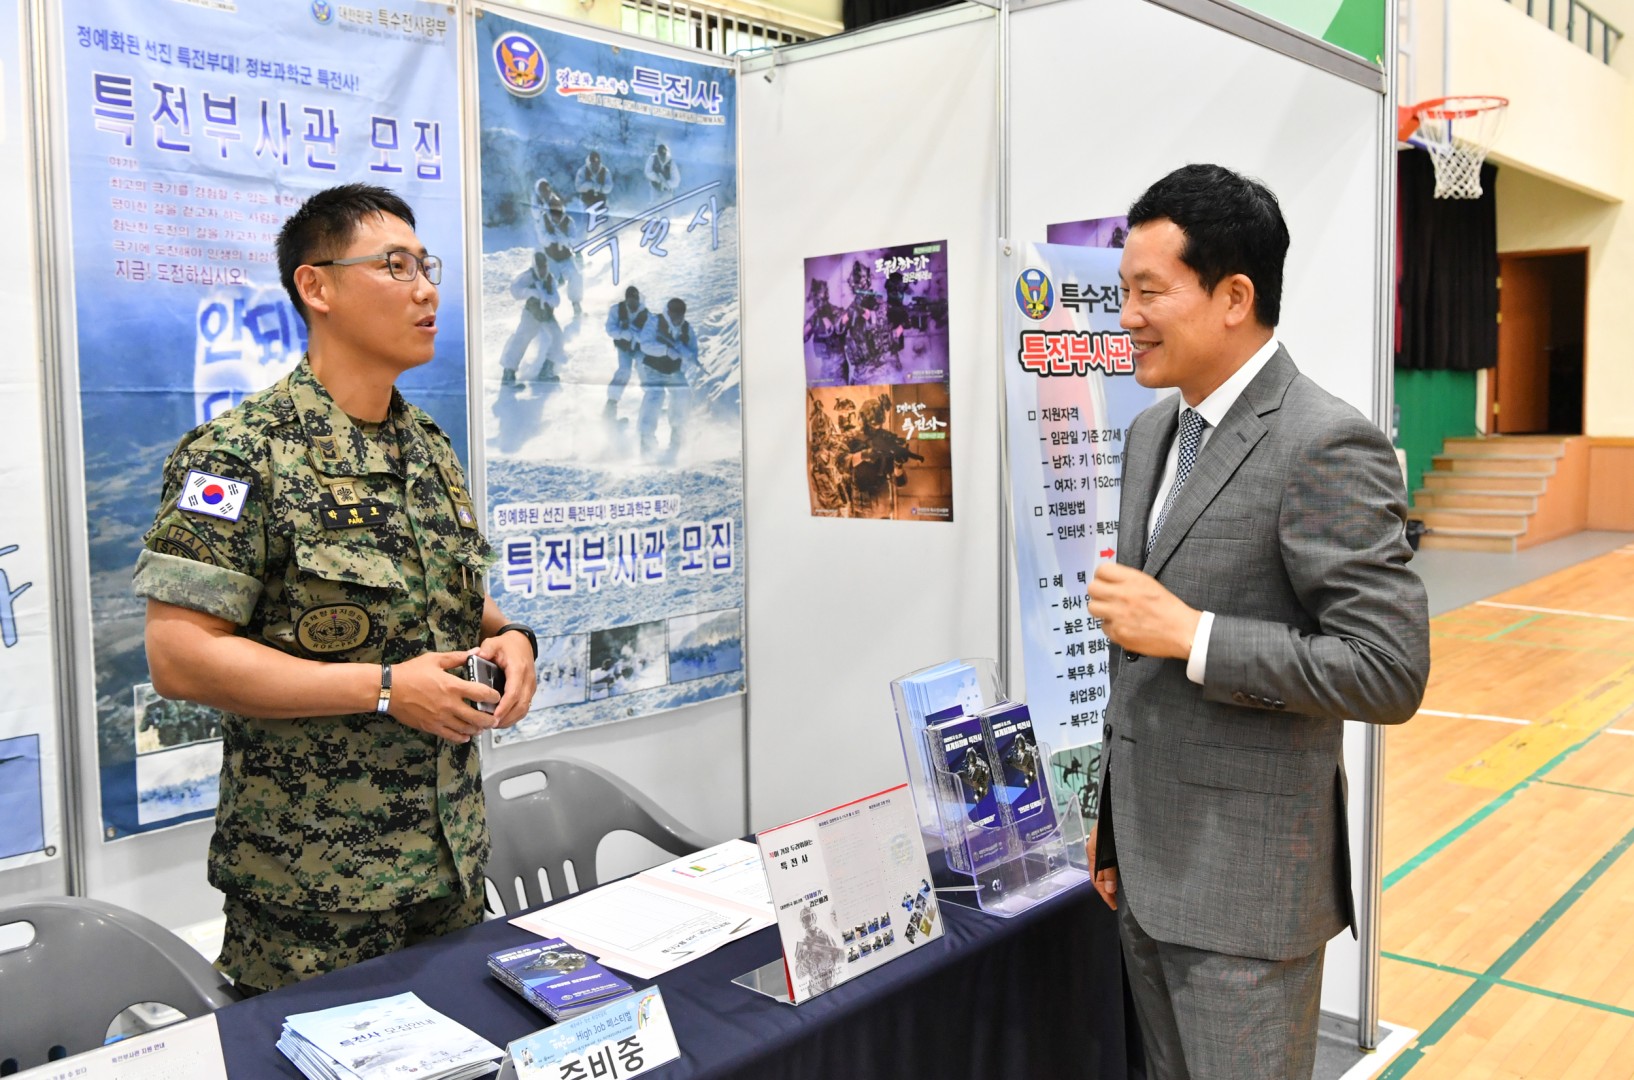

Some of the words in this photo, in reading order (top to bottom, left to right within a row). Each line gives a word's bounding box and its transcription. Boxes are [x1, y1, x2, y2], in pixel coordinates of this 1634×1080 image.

[377, 8, 447, 38] 특수전사령부
[76, 25, 141, 56] 정예화된
[145, 40, 172, 65] 선진
[176, 46, 240, 75] 특전부대!
[245, 57, 313, 86] 정보과학군
[317, 68, 360, 92] 특전사!
[632, 67, 723, 113] 특전사
[93, 72, 339, 170] 특전부사관
[370, 114, 443, 181] 모집
[110, 177, 146, 192] 최고의
[153, 223, 190, 238] 도전의
[113, 239, 150, 253] 극기에
[115, 259, 151, 281] 지금!
[157, 263, 248, 287] 도전하십시오!
[874, 254, 930, 280] 도전하라
[1060, 282, 1122, 314] 특수전
[1020, 332, 1135, 376] 특전부사관
[1041, 407, 1079, 422] 지원자격
[901, 416, 947, 441] 특전사
[1050, 431, 1079, 445] 임관일
[1082, 430, 1099, 444] 기준
[1102, 428, 1122, 442] 27세
[1052, 454, 1075, 469] 남자:
[1079, 453, 1088, 467] 키
[1054, 477, 1077, 493] 여자:
[1081, 476, 1090, 490] 키
[497, 507, 540, 527] 정예화된
[542, 507, 565, 524] 선진
[567, 504, 607, 523] 특전부대!
[609, 501, 652, 520] 정보과학군
[654, 497, 679, 515] 특전사!
[1048, 500, 1086, 517] 지원방법
[347, 517, 364, 525] PARK
[1057, 525, 1086, 541] 인터넷
[506, 528, 666, 595] 특전부사관
[681, 521, 732, 571] 모집
[1052, 574, 1064, 588] 혜
[1077, 570, 1087, 584] 택
[1062, 595, 1082, 612] 하사
[1063, 619, 1084, 636] 높은
[1065, 642, 1086, 659] 세계
[1066, 664, 1096, 682] 복무후
[1098, 660, 1110, 677] 사
[1069, 684, 1106, 705] 취업용이
[1070, 710, 1098, 728] 복무간
[384, 1018, 437, 1034] 모집안내
[575, 1028, 593, 1041] High
[593, 1022, 606, 1035] Job
[606, 1011, 633, 1028] 페스티벌
